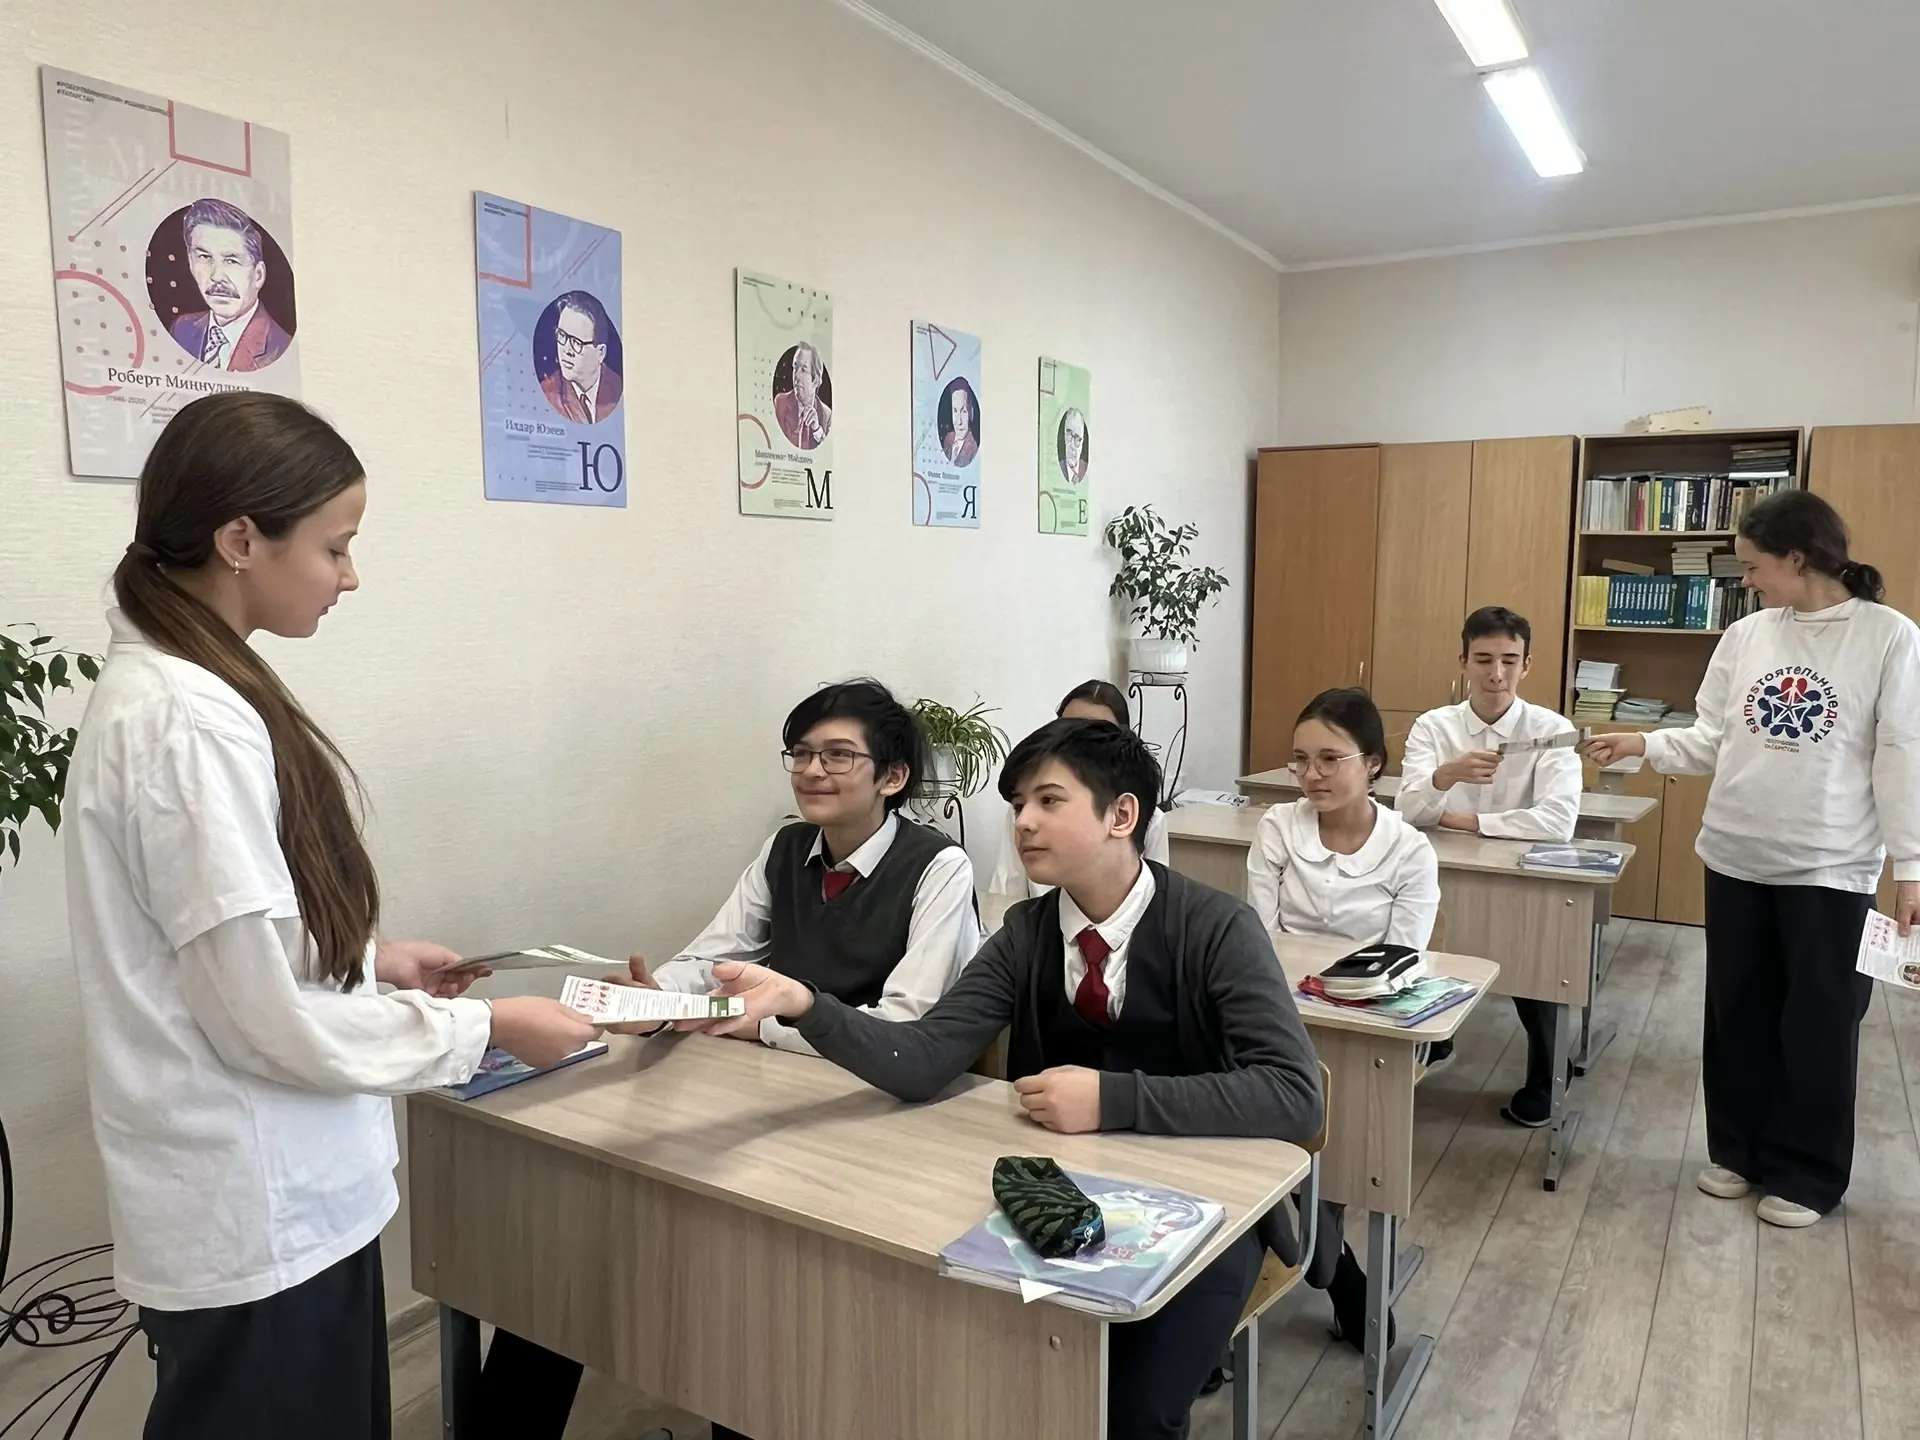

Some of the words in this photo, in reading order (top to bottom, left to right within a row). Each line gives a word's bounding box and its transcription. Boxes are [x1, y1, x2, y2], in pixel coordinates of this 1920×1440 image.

[107, 367, 162, 387] Роберт
[577, 441, 623, 492] Ю
[804, 468, 833, 509] М
[961, 485, 977, 519] Я
[1078, 498, 1088, 524] Е
